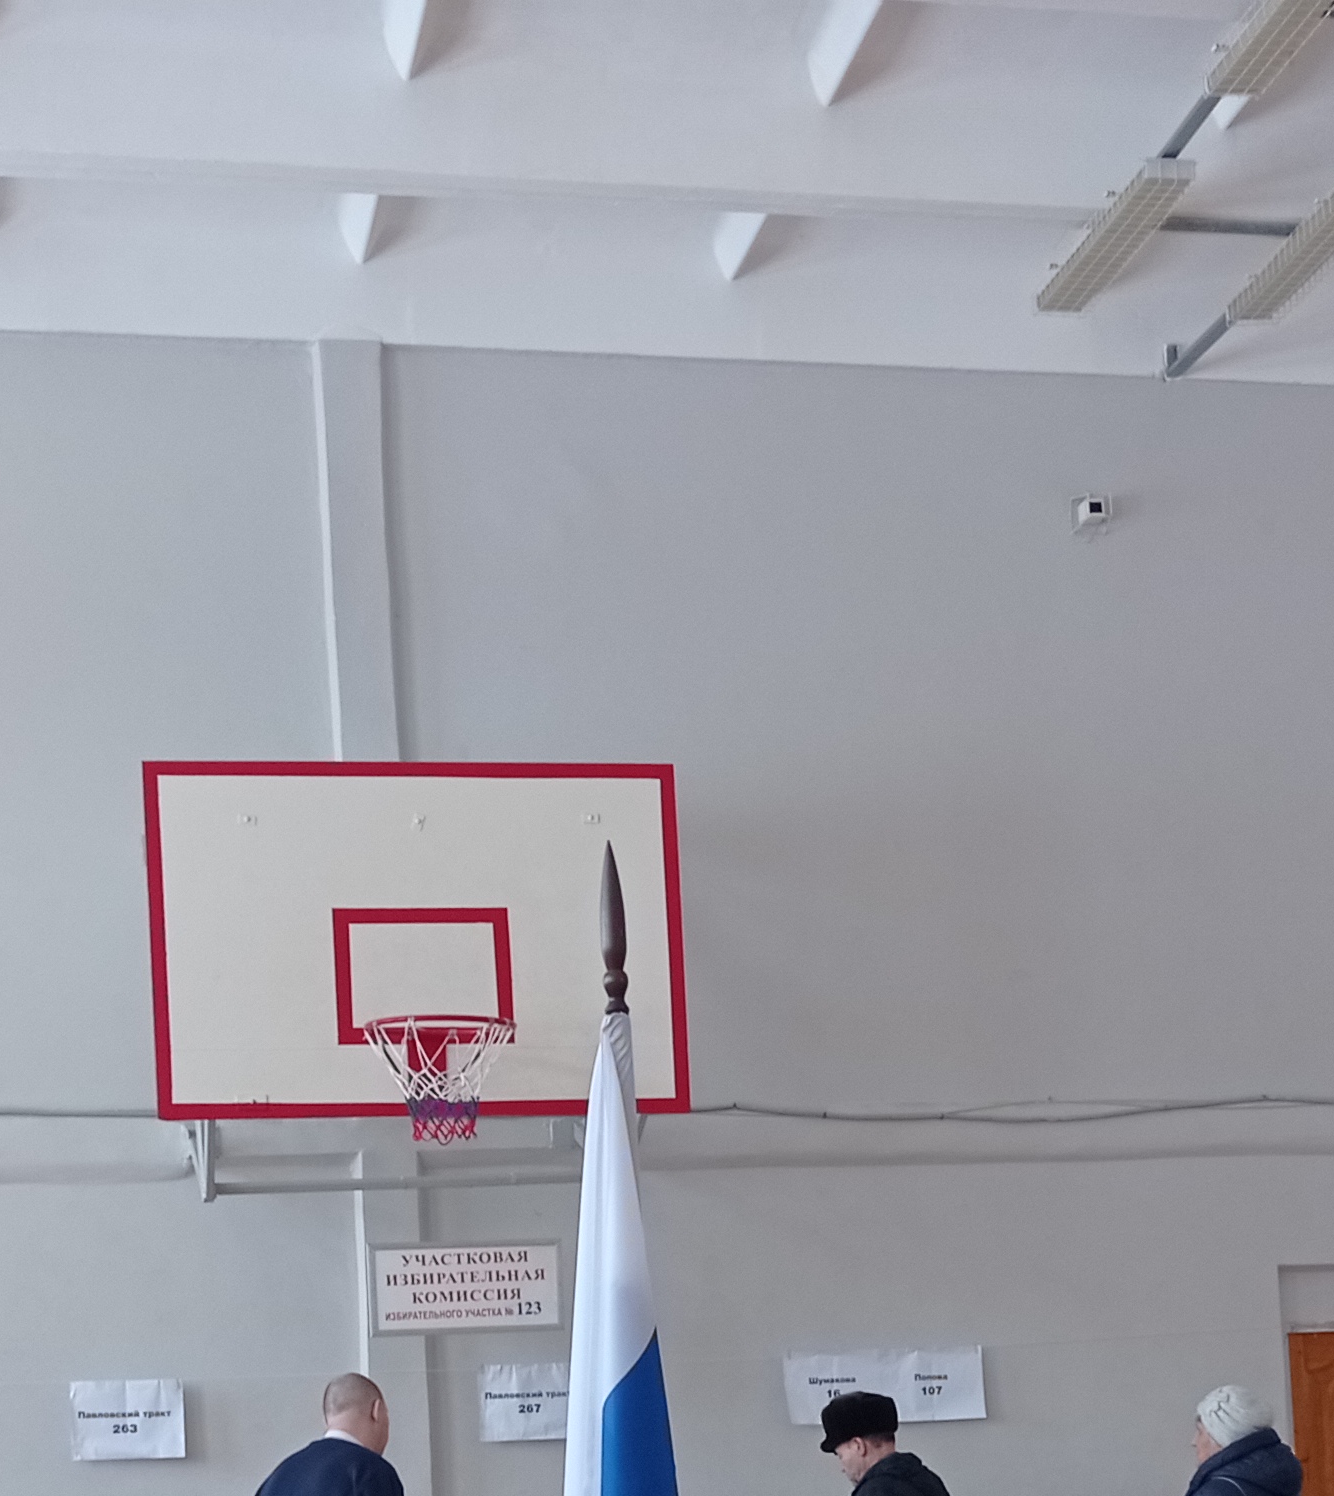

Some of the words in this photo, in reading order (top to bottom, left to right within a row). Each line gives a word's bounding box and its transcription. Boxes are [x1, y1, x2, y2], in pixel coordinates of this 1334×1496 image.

[401, 1250, 529, 1267] УЧАСТКОВАЯ
[386, 1268, 546, 1287] ИЗБИРАТЕЛЬНАЯ
[412, 1287, 522, 1304] КОМИССИЯ
[385, 1308, 463, 1322] ИЗБИРАТЕЛЬНОГО
[464, 1307, 502, 1319] УЧАСТКА
[517, 1301, 542, 1316] 123
[484, 1390, 543, 1400] Павловский
[921, 1386, 943, 1396] 107
[518, 1403, 542, 1414] 267
[77, 1410, 140, 1420] Павловский
[143, 1410, 172, 1419] тракт
[112, 1423, 138, 1434] 263
